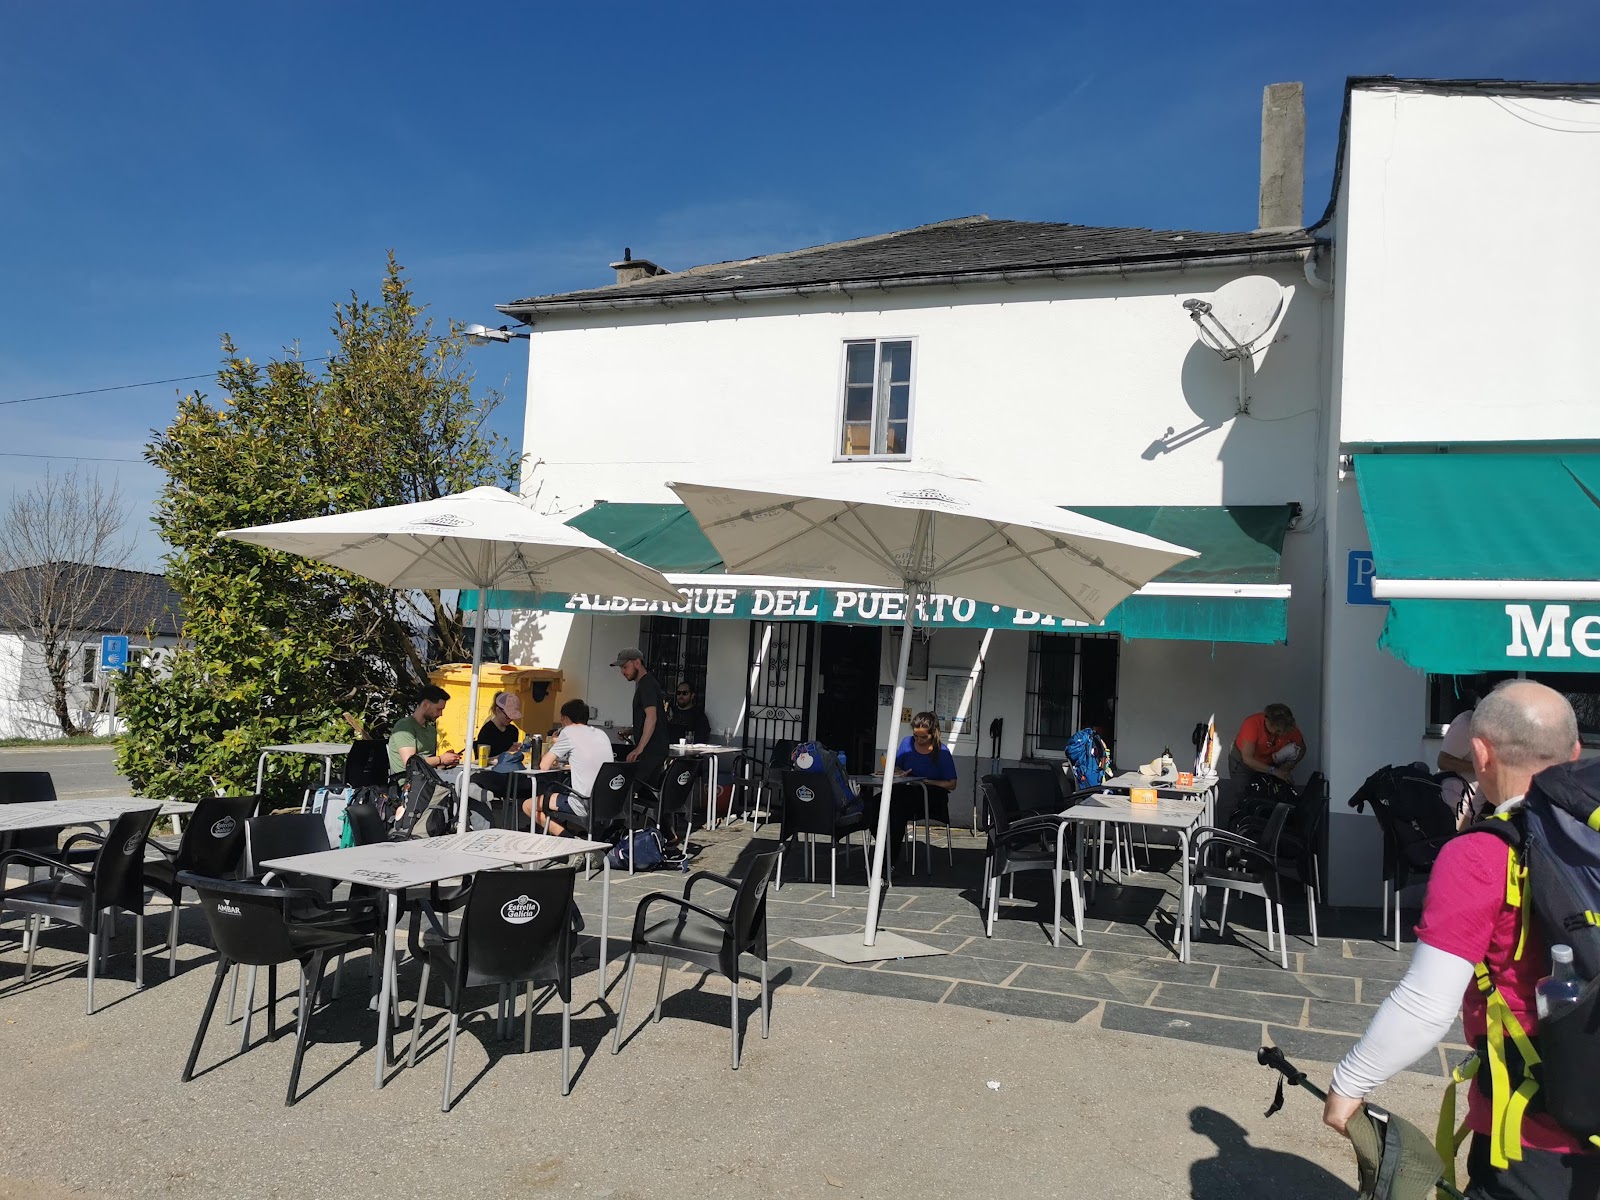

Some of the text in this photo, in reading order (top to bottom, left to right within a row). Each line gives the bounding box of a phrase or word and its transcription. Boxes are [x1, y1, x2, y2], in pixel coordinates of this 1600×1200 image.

[751, 589, 819, 616] DEL
[832, 591, 976, 622] PUERTO
[217, 903, 241, 914] AMBAR
